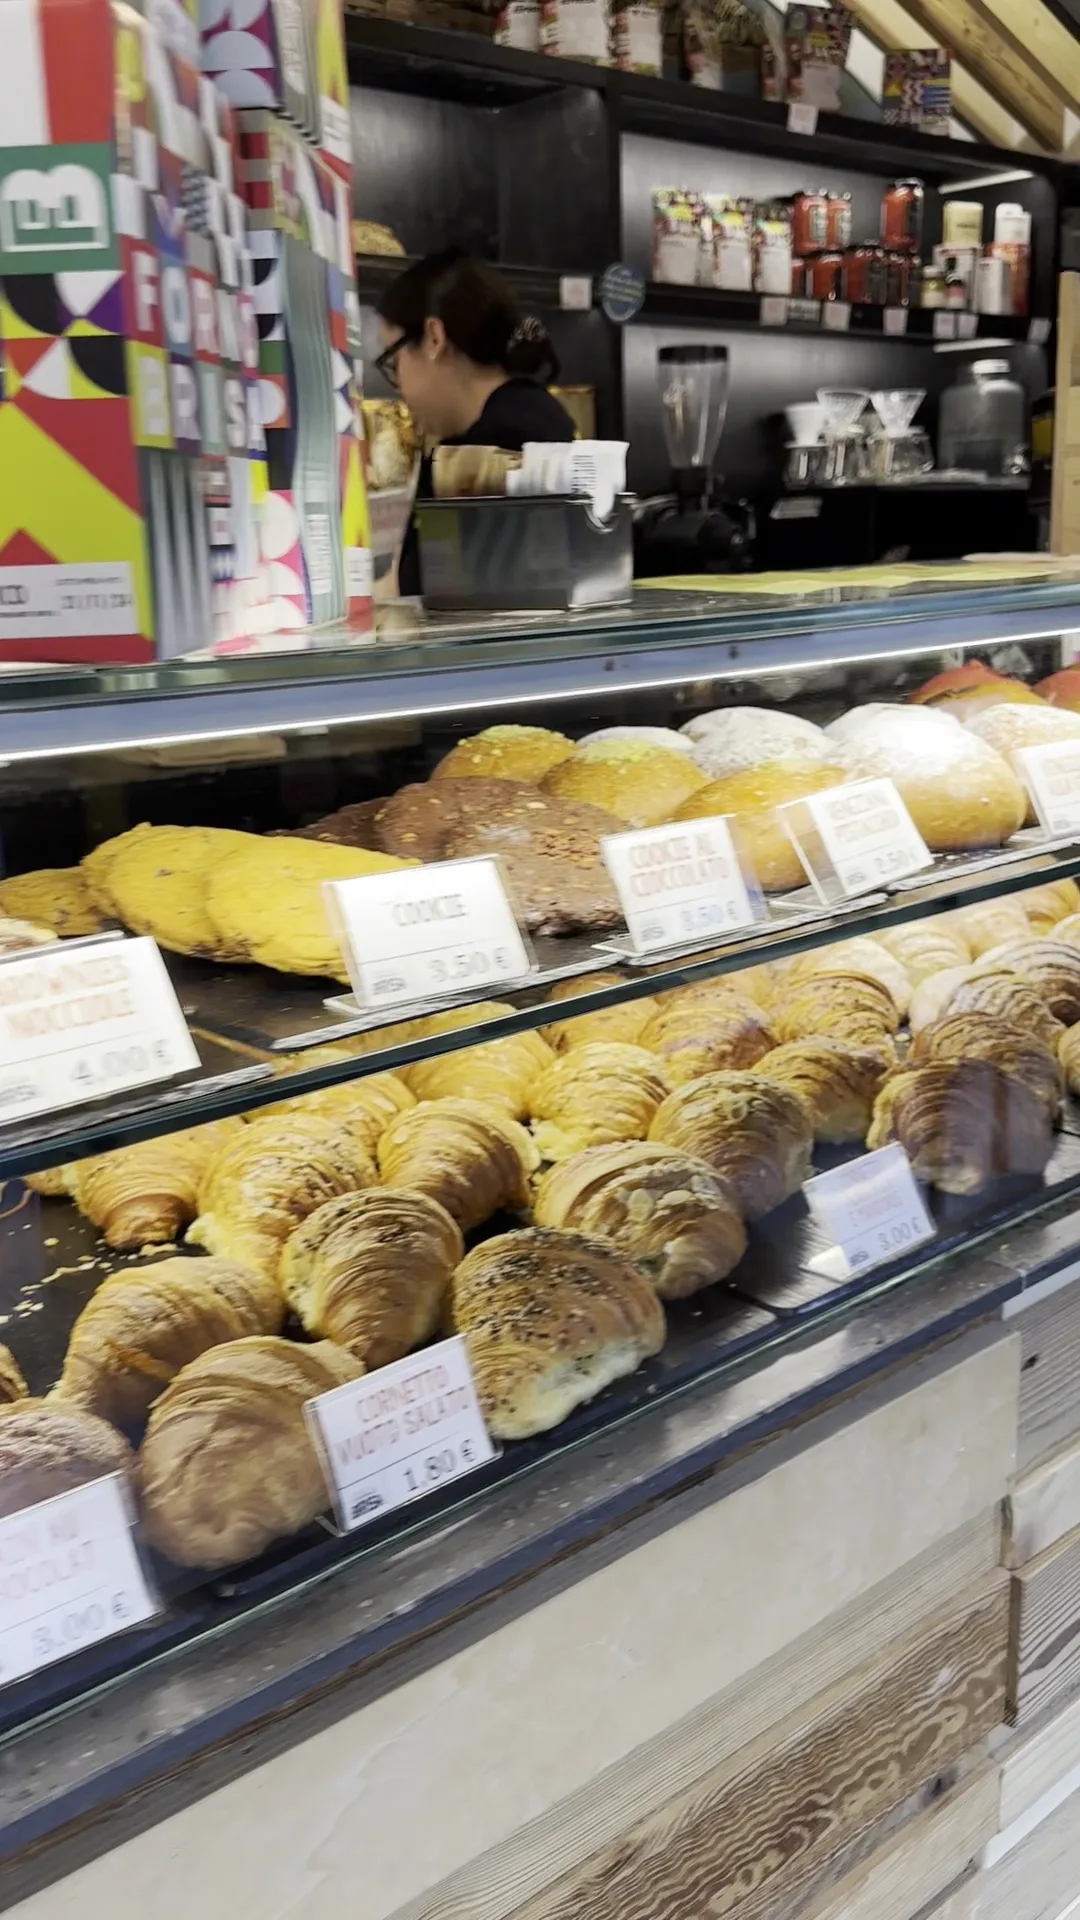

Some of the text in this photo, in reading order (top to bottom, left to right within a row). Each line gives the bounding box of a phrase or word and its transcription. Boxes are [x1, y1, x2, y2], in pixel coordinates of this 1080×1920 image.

[391, 893, 469, 928] COOKIE
[428, 946, 510, 984] 3.50 €
[152, 1038, 174, 1066] €
[356, 1364, 450, 1424] CORNETTO
[333, 1385, 472, 1467] VUOTO SALATO
[402, 1437, 478, 1493] 1.80 €
[110, 1588, 133, 1620] €
